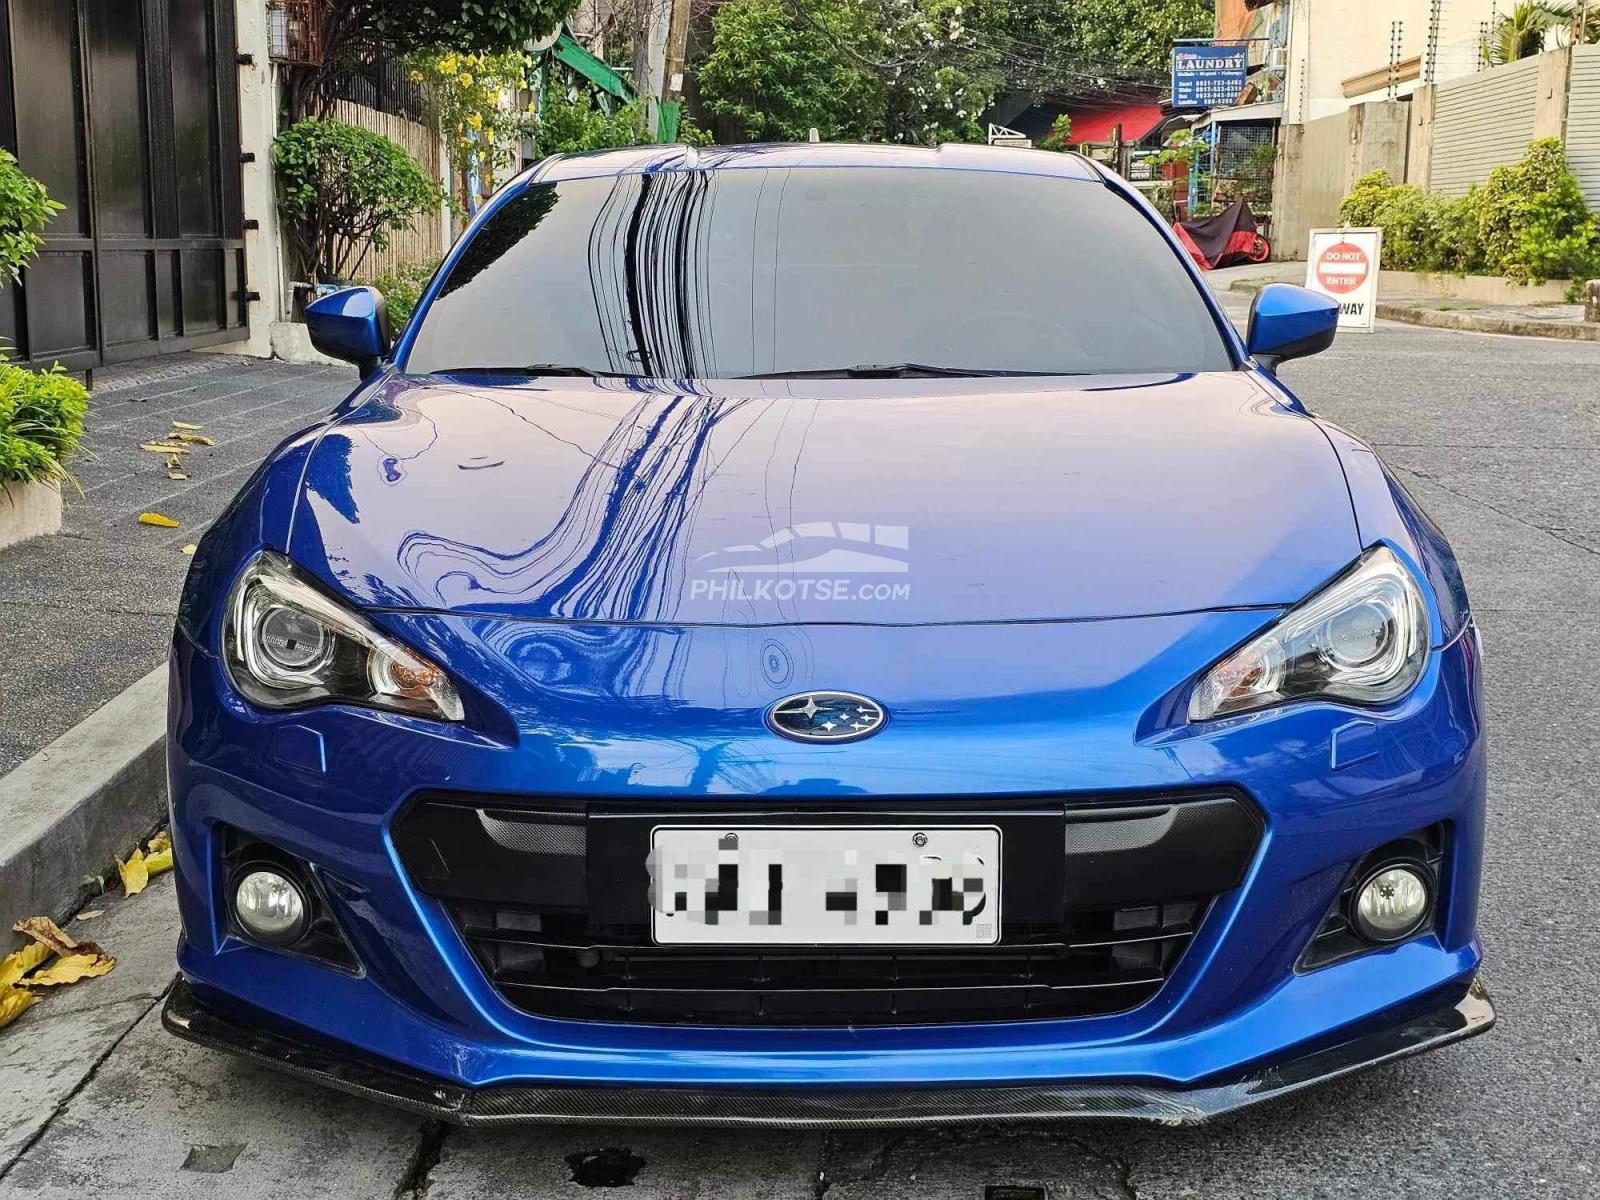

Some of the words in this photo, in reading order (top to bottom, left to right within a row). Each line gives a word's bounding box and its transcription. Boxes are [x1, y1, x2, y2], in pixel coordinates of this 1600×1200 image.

[1178, 59, 1242, 69] LAUNDRY
[1326, 252, 1340, 260] DO
[1342, 252, 1360, 260] NOT
[1326, 276, 1356, 285] ENTER
[1339, 302, 1364, 315] WAY
